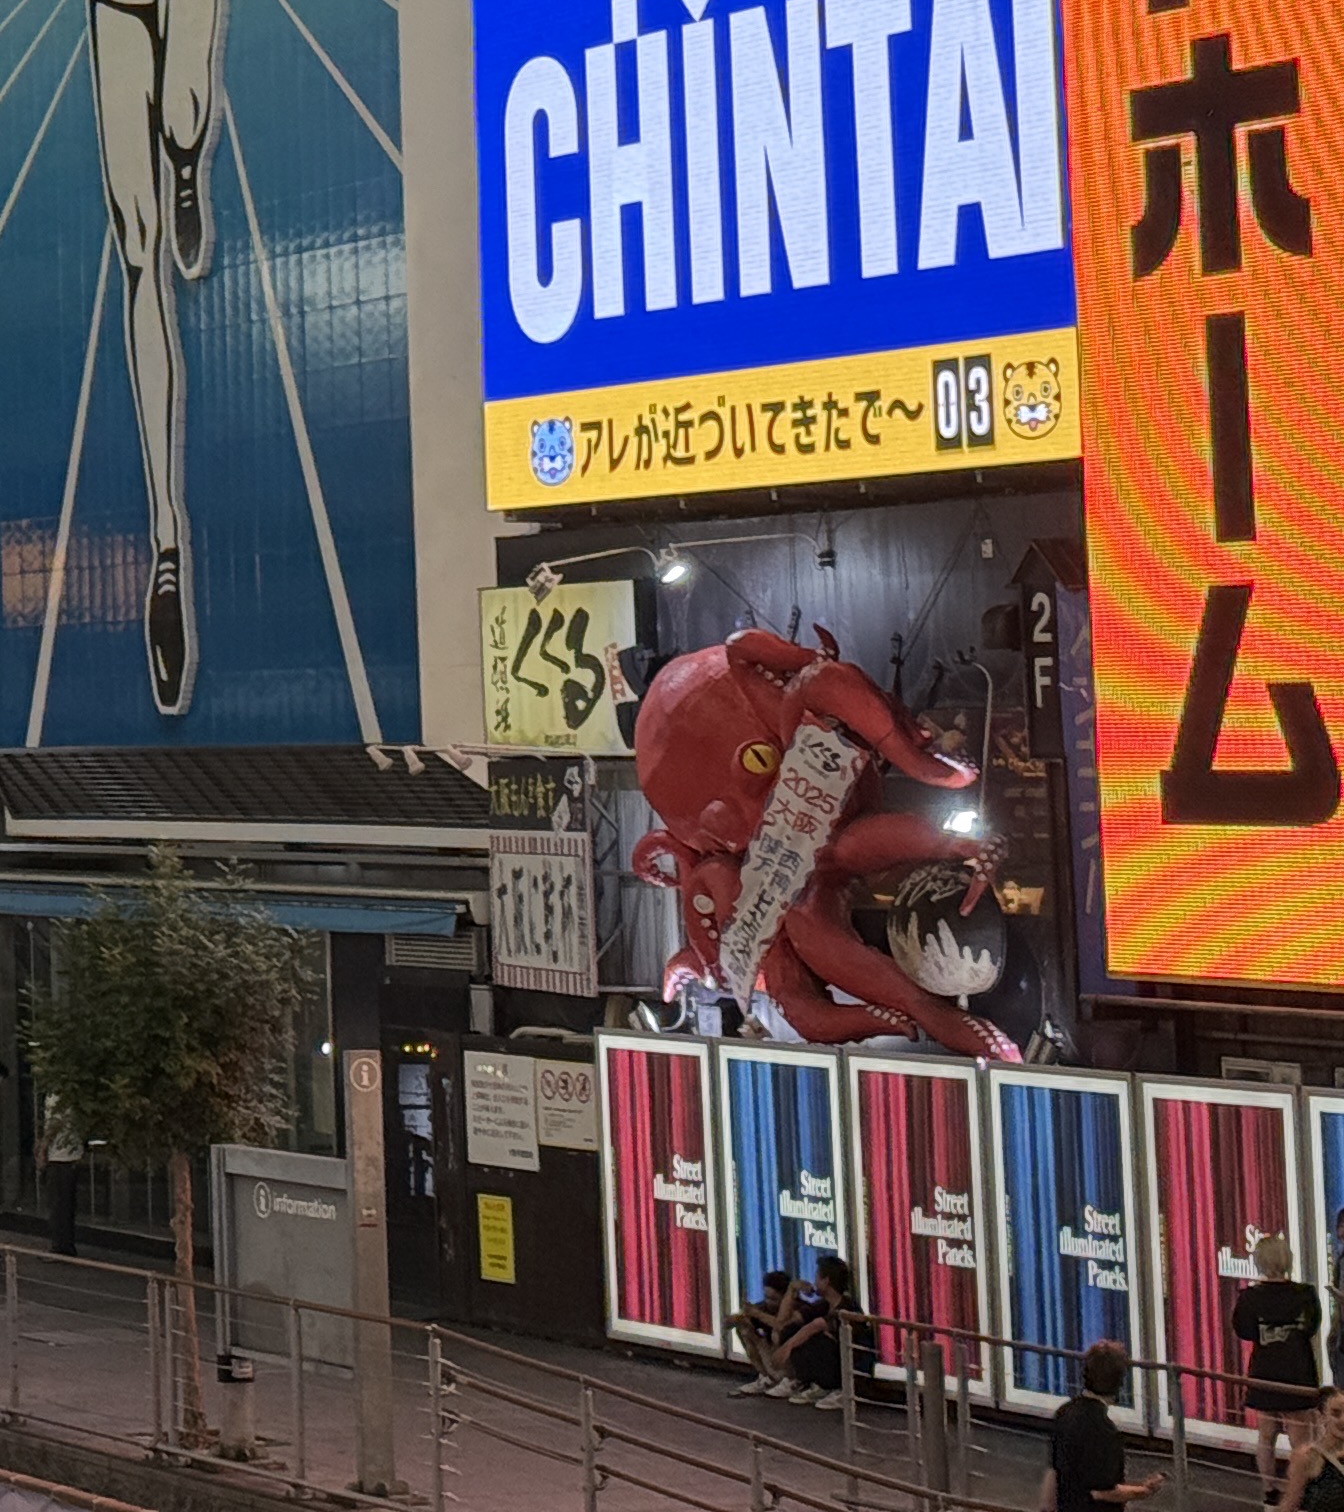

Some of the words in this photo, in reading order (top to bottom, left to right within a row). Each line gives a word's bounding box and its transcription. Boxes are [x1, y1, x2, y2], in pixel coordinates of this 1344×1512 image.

[673, 1153, 704, 1182] Street
[800, 1169, 832, 1199] Street
[273, 1193, 337, 1222] information
[934, 1185, 970, 1216] Street
[1084, 1203, 1121, 1236] Street
